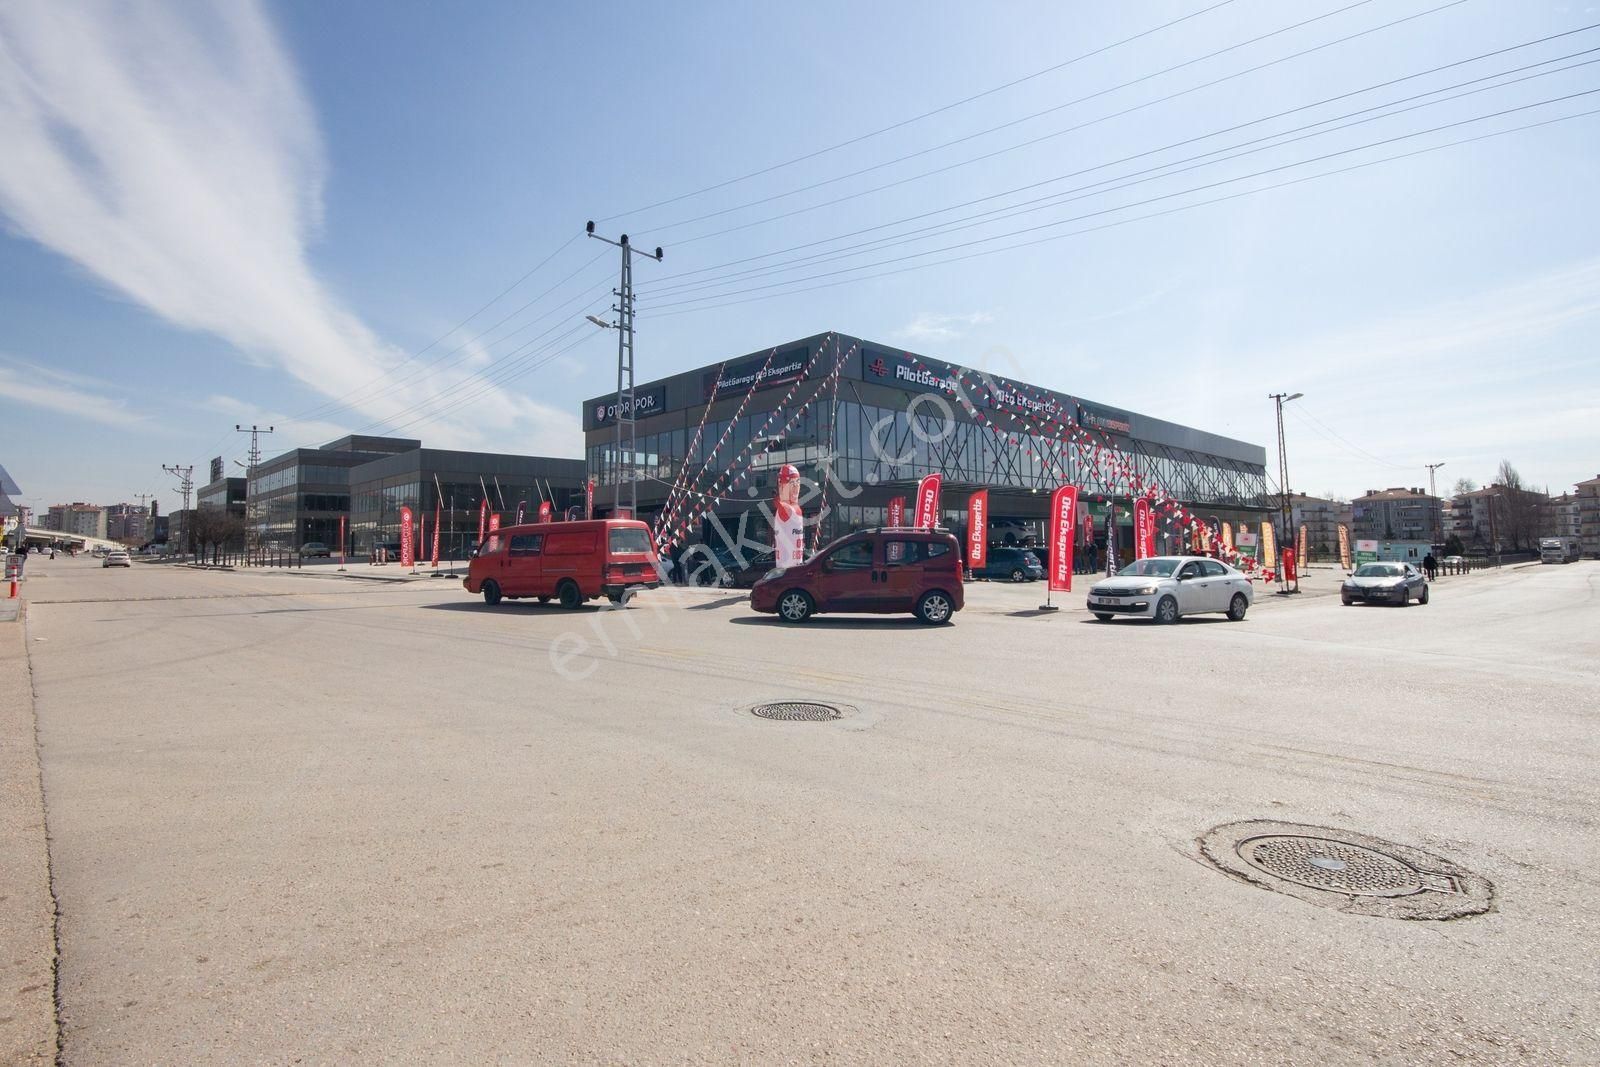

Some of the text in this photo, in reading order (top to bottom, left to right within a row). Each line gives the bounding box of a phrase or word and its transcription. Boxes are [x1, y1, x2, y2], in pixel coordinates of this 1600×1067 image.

[718, 374, 755, 389] PilotGarage
[768, 362, 802, 377] Ekspertiz
[896, 365, 958, 391] PilotGarage
[607, 396, 655, 417] OTORPOR
[924, 490, 934, 512] Oto
[971, 499, 983, 560] Oto Ekspertiz
[1057, 496, 1071, 582] Oto Ekspertiz
